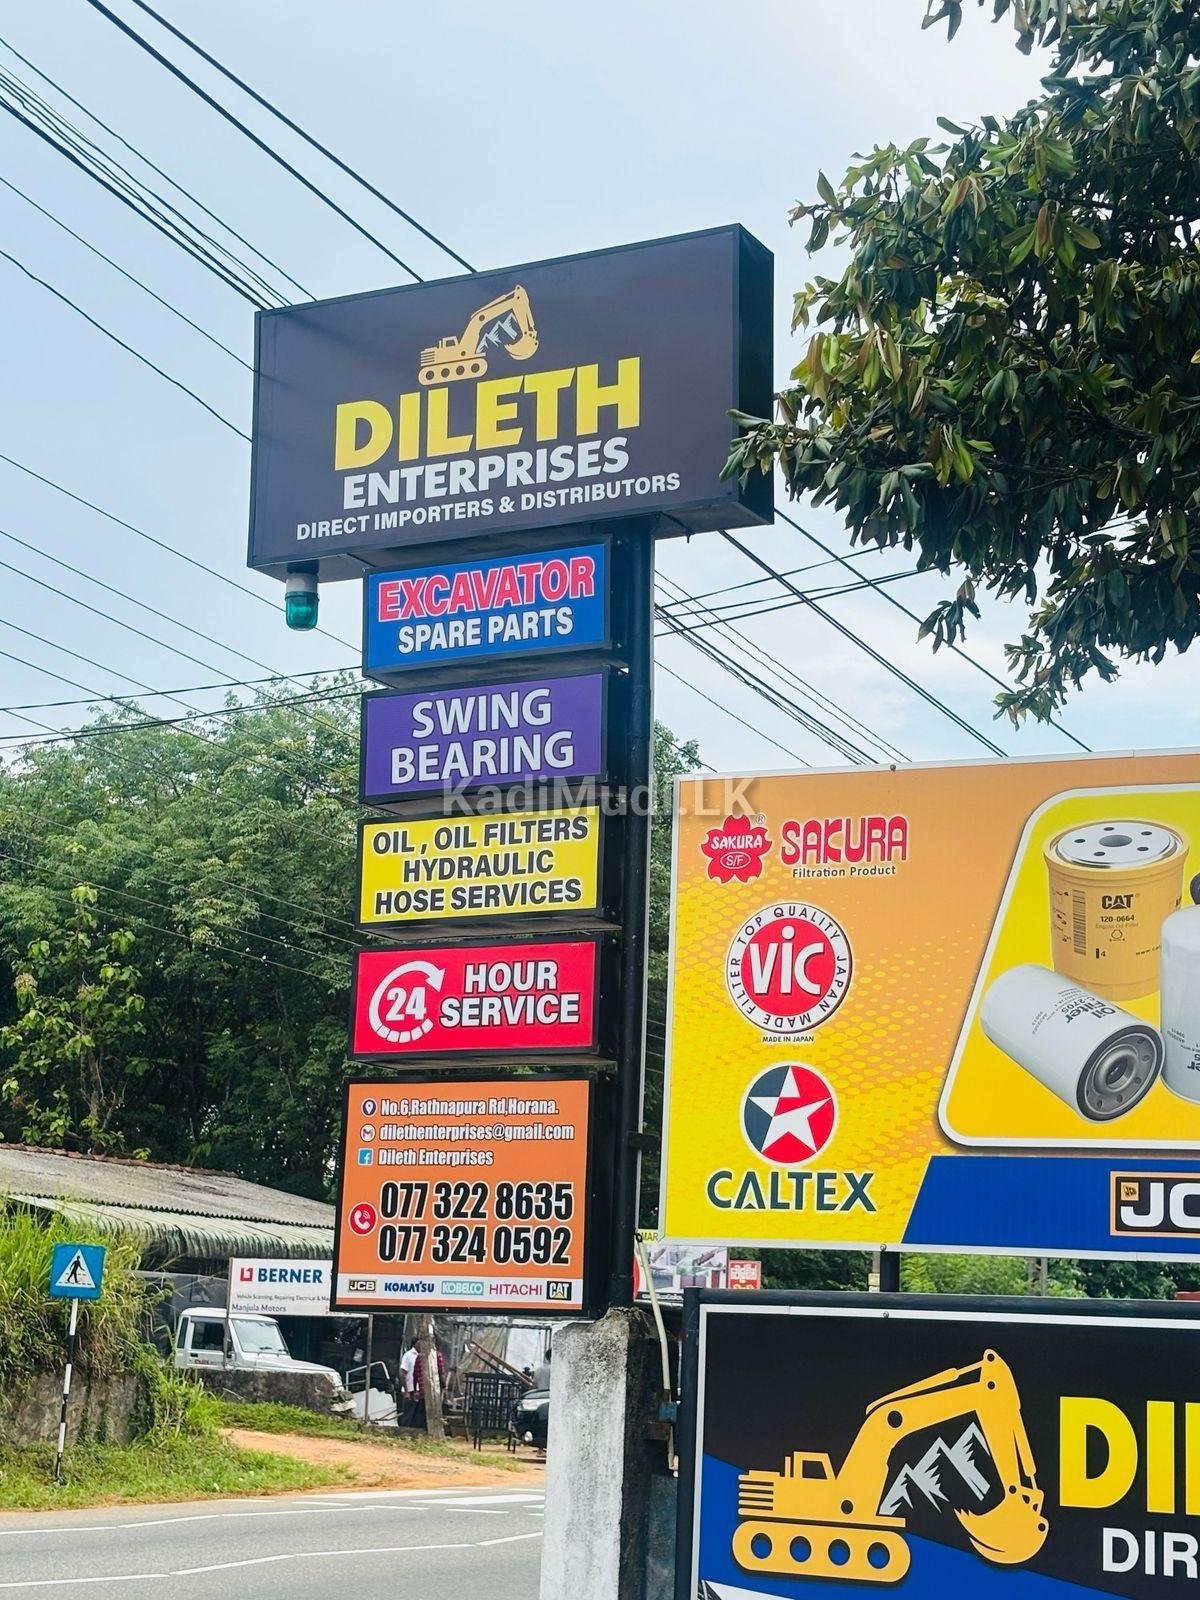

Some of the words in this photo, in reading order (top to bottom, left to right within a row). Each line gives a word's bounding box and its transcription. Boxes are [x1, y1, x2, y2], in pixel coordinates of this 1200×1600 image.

[334, 356, 641, 470] DILETH
[343, 436, 630, 510] ENTERPRISES
[296, 514, 368, 541] DIRECT
[374, 498, 494, 531] IMPORTERS
[499, 496, 515, 513] &
[520, 472, 681, 511] DISTRIBUTORS
[378, 555, 595, 622] EXCAVATOR
[397, 612, 484, 654] SPARE
[487, 605, 574, 646] PARTS
[411, 688, 552, 739] SWING
[391, 730, 575, 785] BEARING
[434, 824, 477, 850] OIL
[484, 816, 589, 846] FILTERS
[710, 834, 763, 850] SAKURA
[781, 815, 908, 865] SAKURA
[403, 850, 554, 883] HYDRAULIC
[726, 854, 745, 867] S/F
[792, 866, 846, 879] Filtration
[850, 865, 897, 877] Product
[375, 888, 445, 915] HOSE
[450, 879, 582, 909] SERVICES
[1101, 894, 1134, 910] CAT
[736, 916, 764, 945] TOP
[773, 905, 841, 941] QUALITY
[464, 960, 559, 994] HOUR
[730, 957, 756, 1016] FILTER
[817, 956, 848, 1014] JAPAN
[386, 987, 427, 1022] 24
[439, 993, 580, 1028] SERVICE
[763, 1013, 813, 1029] MADE
[379, 1123, 575, 1141] dilethenterprises@gmail.com
[378, 1149, 417, 1166] Dileth
[418, 1148, 494, 1167] Enterprises
[380, 1181, 430, 1219] 077
[433, 1181, 489, 1221] 322
[494, 1181, 574, 1222] 8635
[707, 1170, 877, 1212] CALTEX
[378, 1224, 428, 1263] 077
[431, 1224, 488, 1264] 324
[493, 1225, 573, 1266] 0592
[257, 1267, 323, 1284] BERNER
[350, 1280, 376, 1291] JCB
[384, 1280, 435, 1293] KOMATSU
[442, 1281, 483, 1294] KOBELCO
[489, 1284, 543, 1296] HITACHI
[549, 1282, 570, 1299] CAT
[232, 1303, 259, 1313] Manjula
[261, 1303, 287, 1312] Motors
[1059, 1396, 1200, 1516] DI
